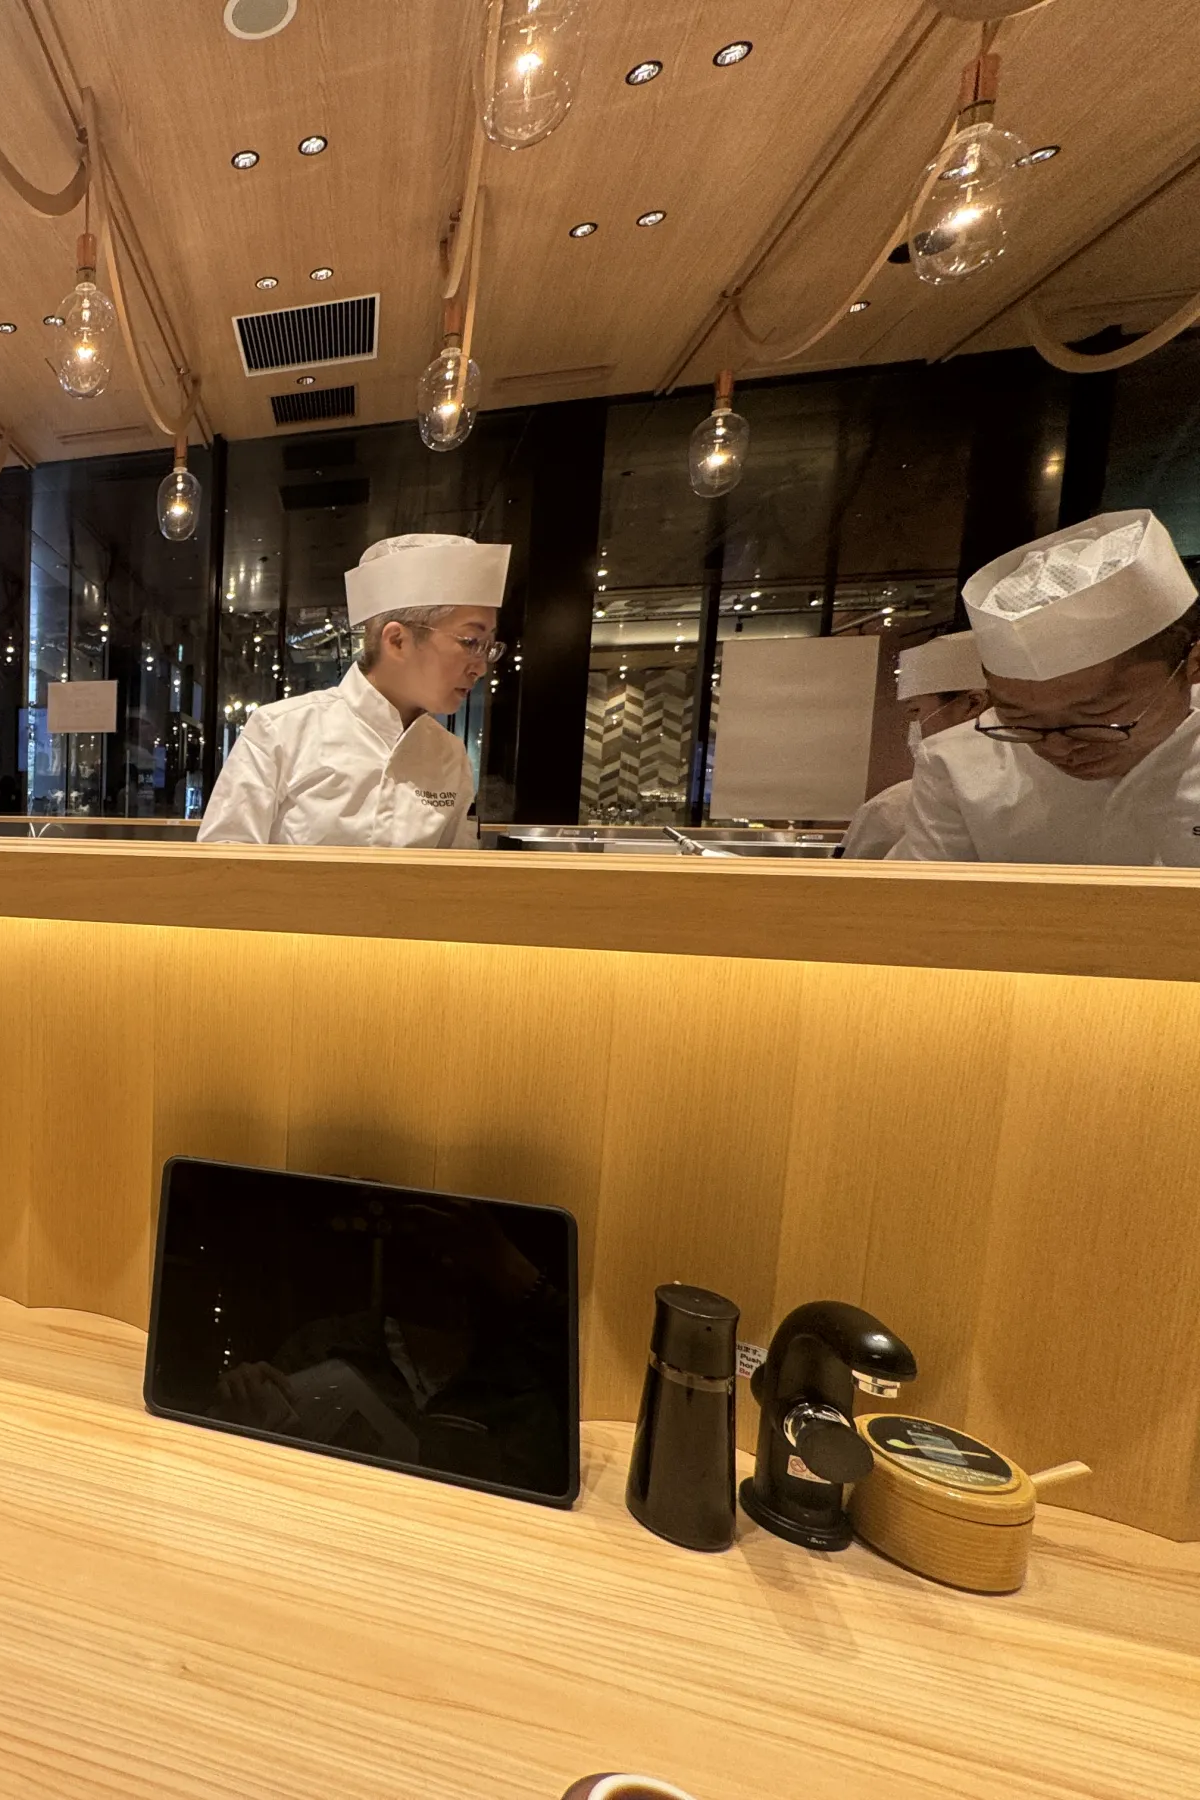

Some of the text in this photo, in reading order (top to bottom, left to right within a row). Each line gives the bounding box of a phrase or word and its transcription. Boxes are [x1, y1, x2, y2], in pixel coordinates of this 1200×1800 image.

[415, 789, 437, 799] SUSHI
[421, 799, 454, 807] ONODER
[740, 1353, 762, 1365] Push
[739, 1361, 754, 1370] hot
